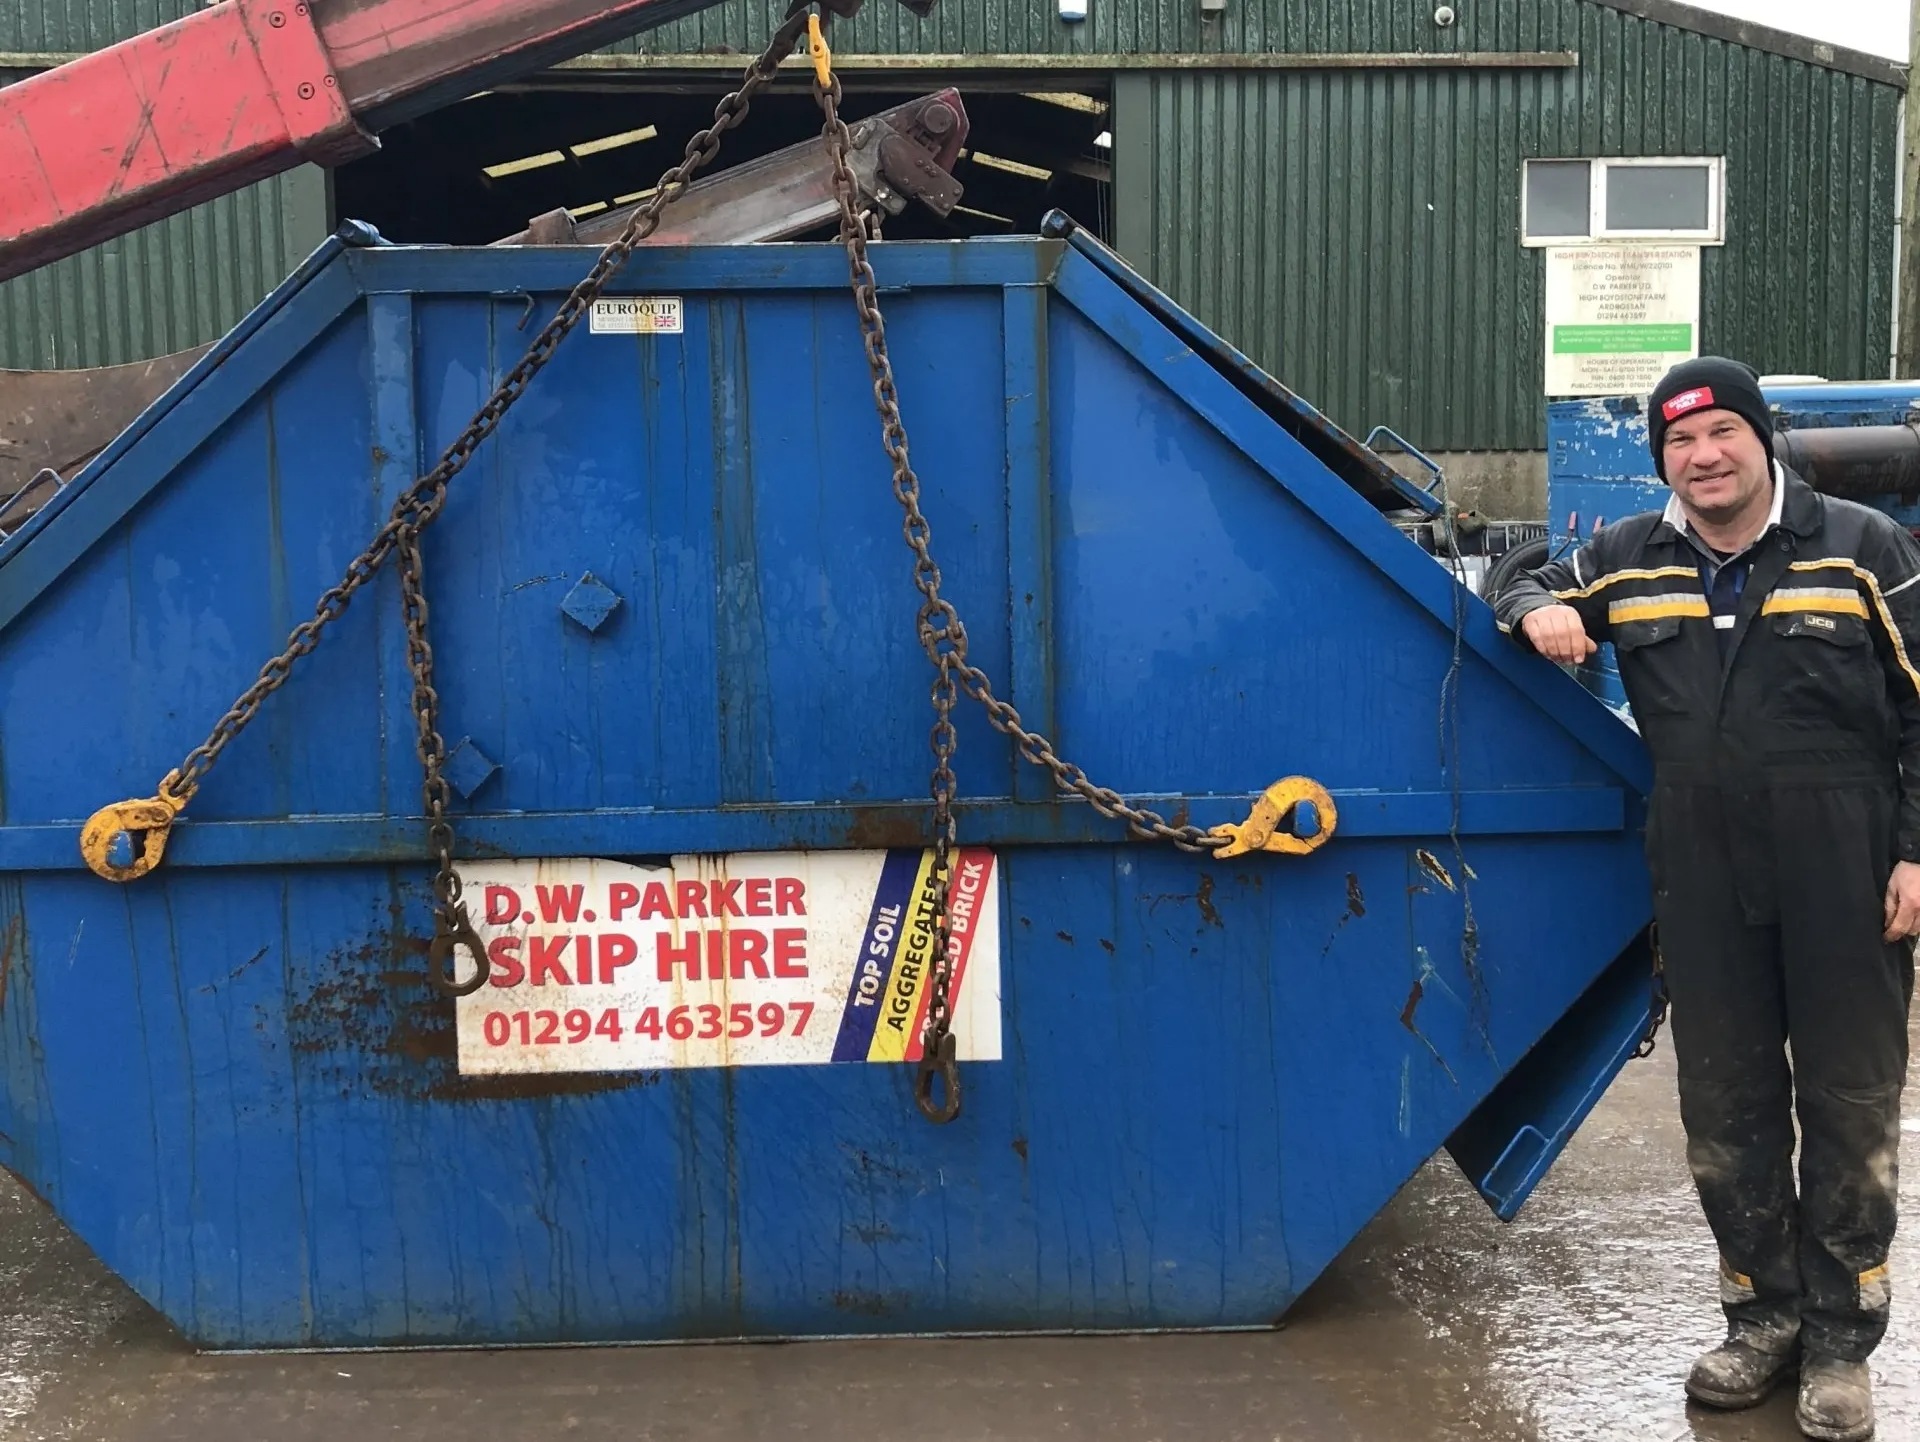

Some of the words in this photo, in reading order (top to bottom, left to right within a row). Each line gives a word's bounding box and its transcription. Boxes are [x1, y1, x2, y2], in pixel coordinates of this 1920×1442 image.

[1572, 263, 1604, 271] Licence
[1605, 274, 1641, 282] Operator
[596, 303, 677, 316] EUROQUIP
[1807, 617, 1834, 629] JCB
[484, 884, 596, 926] D.W.
[610, 877, 807, 922] PARKER
[952, 859, 984, 934] BRICK
[487, 932, 639, 989] SKIP
[656, 928, 810, 985] HIRE
[854, 959, 882, 1008] TOP
[869, 903, 901, 958] SOIL
[484, 1007, 623, 1047] 01294
[635, 1001, 816, 1041] 463597
